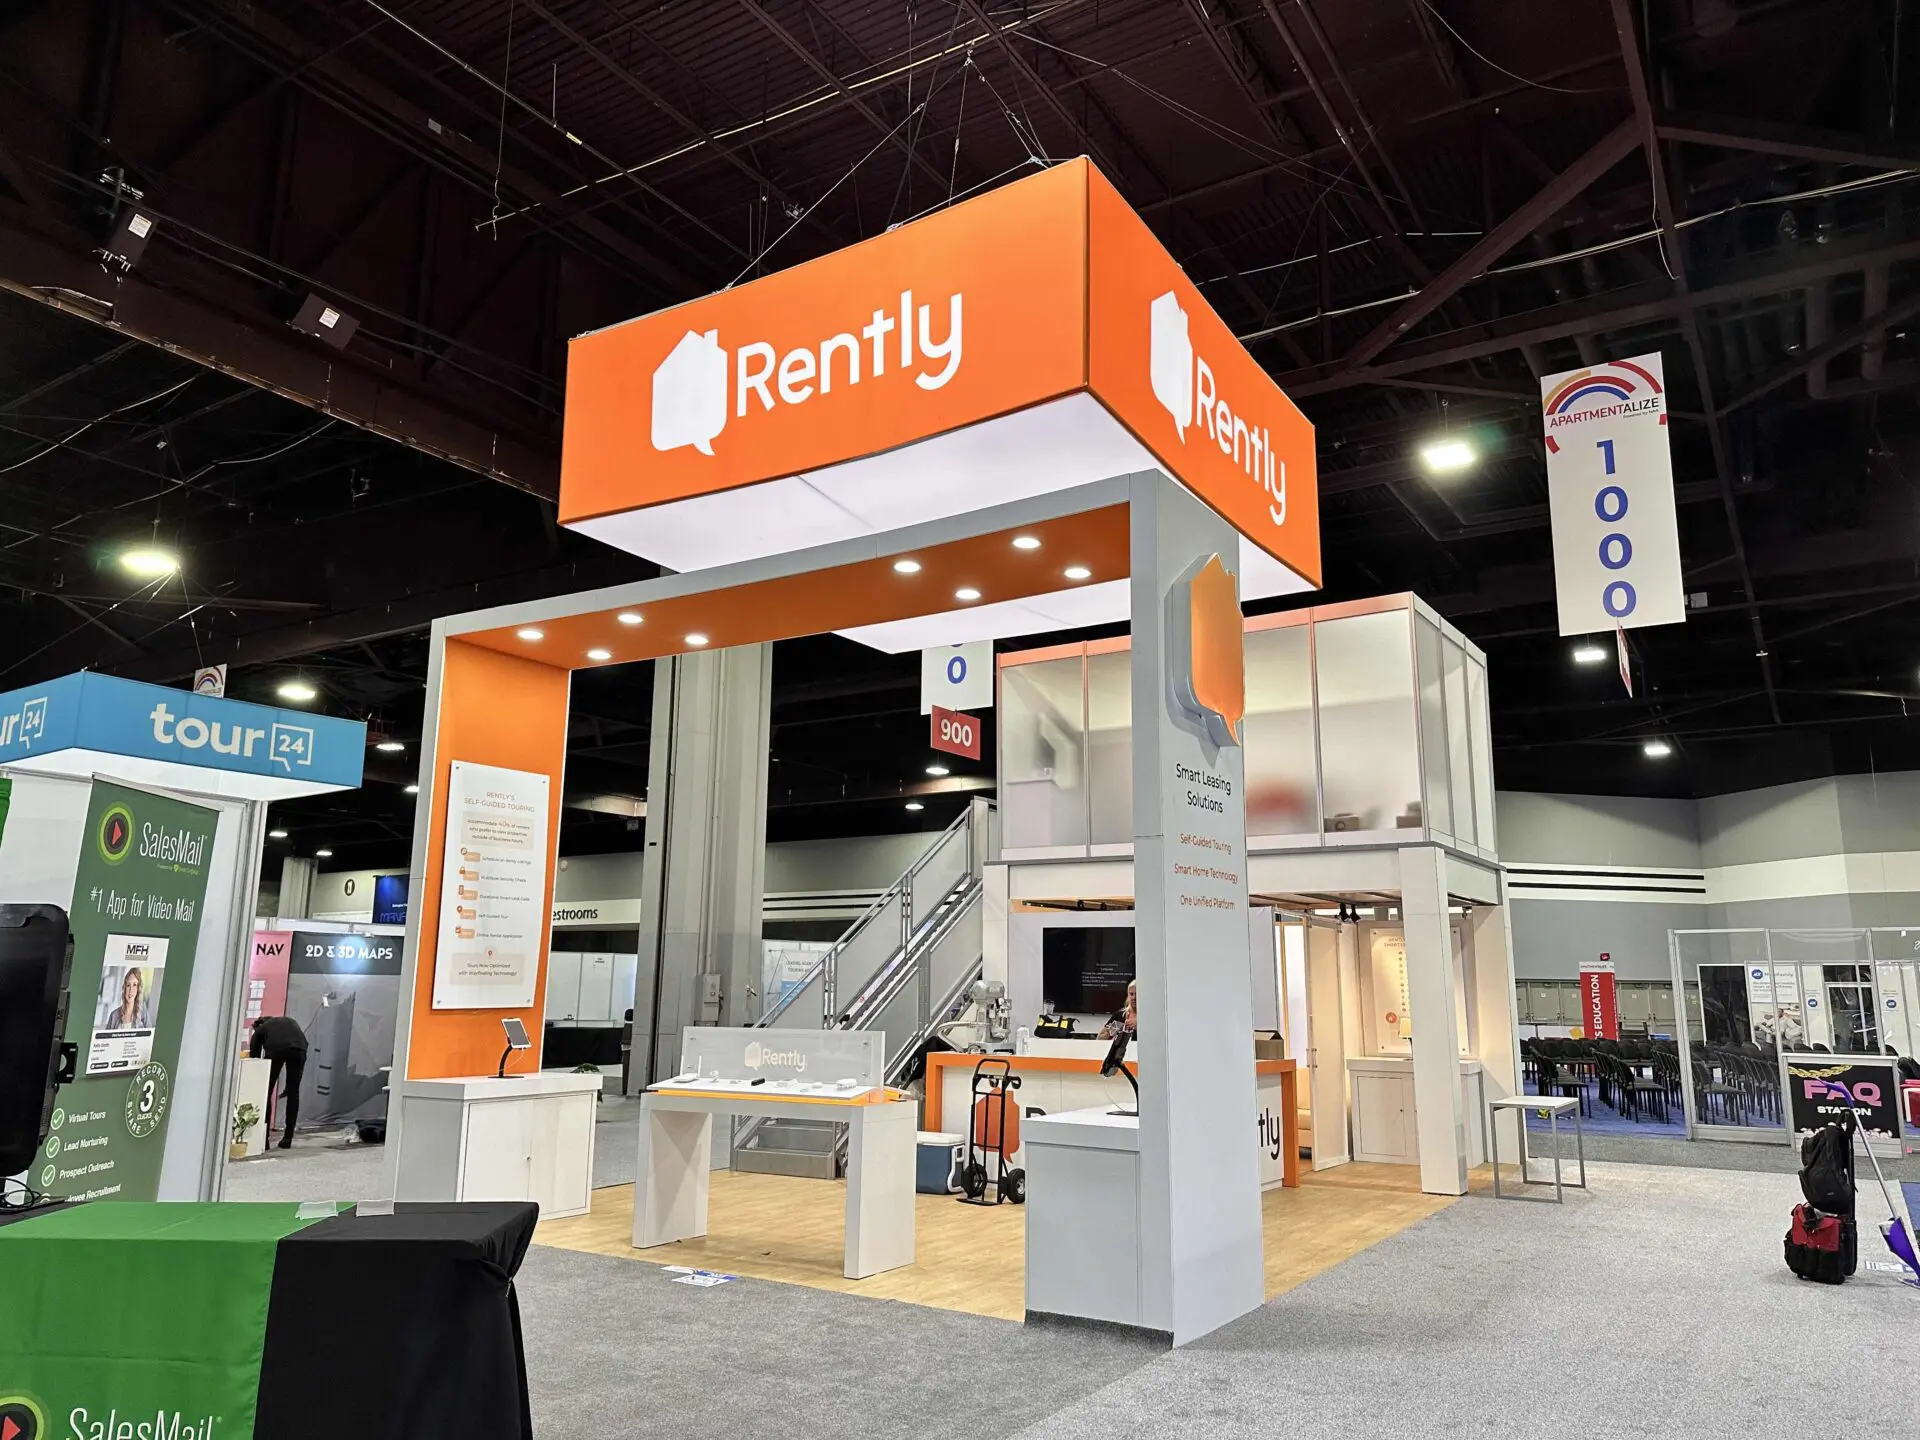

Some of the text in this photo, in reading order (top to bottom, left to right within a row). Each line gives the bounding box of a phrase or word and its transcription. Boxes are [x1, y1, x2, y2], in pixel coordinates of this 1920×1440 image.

[736, 288, 963, 418] Rently
[1550, 397, 1660, 428] APARTMENTALIZE
[1196, 355, 1287, 526] Rently
[946, 644, 967, 684] 0
[25, 708, 41, 729] 24
[150, 703, 305, 757] tour 24
[940, 718, 973, 748] 900
[1176, 763, 1231, 796] Smart Leasing
[463, 797, 535, 813] SELF-GUIDED TOURING
[486, 791, 516, 801] RENTLY'S
[1187, 790, 1224, 814] Solutions
[139, 821, 205, 866] SalesMail
[1180, 833, 1232, 855] Self-Guided Touring
[1174, 863, 1239, 884] Smart Home Technology
[90, 886, 195, 922] #1 App for Video Mail
[1180, 894, 1236, 910] One Unified Platform
[552, 908, 599, 921] estrooms
[126, 944, 150, 955] MFH
[255, 943, 285, 956] NAV
[305, 944, 393, 960] 2D & 3D MAPS
[1589, 973, 1603, 1030] EDUCATION
[762, 1047, 806, 1073] Rently
[136, 1065, 165, 1084] RECORD
[140, 1080, 155, 1112] 3
[1803, 1079, 1882, 1107] FAQ
[68, 1110, 107, 1124] Virtual Tours
[149, 1096, 166, 1128] SEND
[1817, 1106, 1872, 1116] STAON
[63, 1135, 109, 1152] Lead Nurturing
[1258, 1107, 1280, 1161] tly
[59, 1159, 115, 1180] Prospect Outreach
[86, 1183, 122, 1200] Recruitment
[66, 1407, 213, 1440] SalesMail
